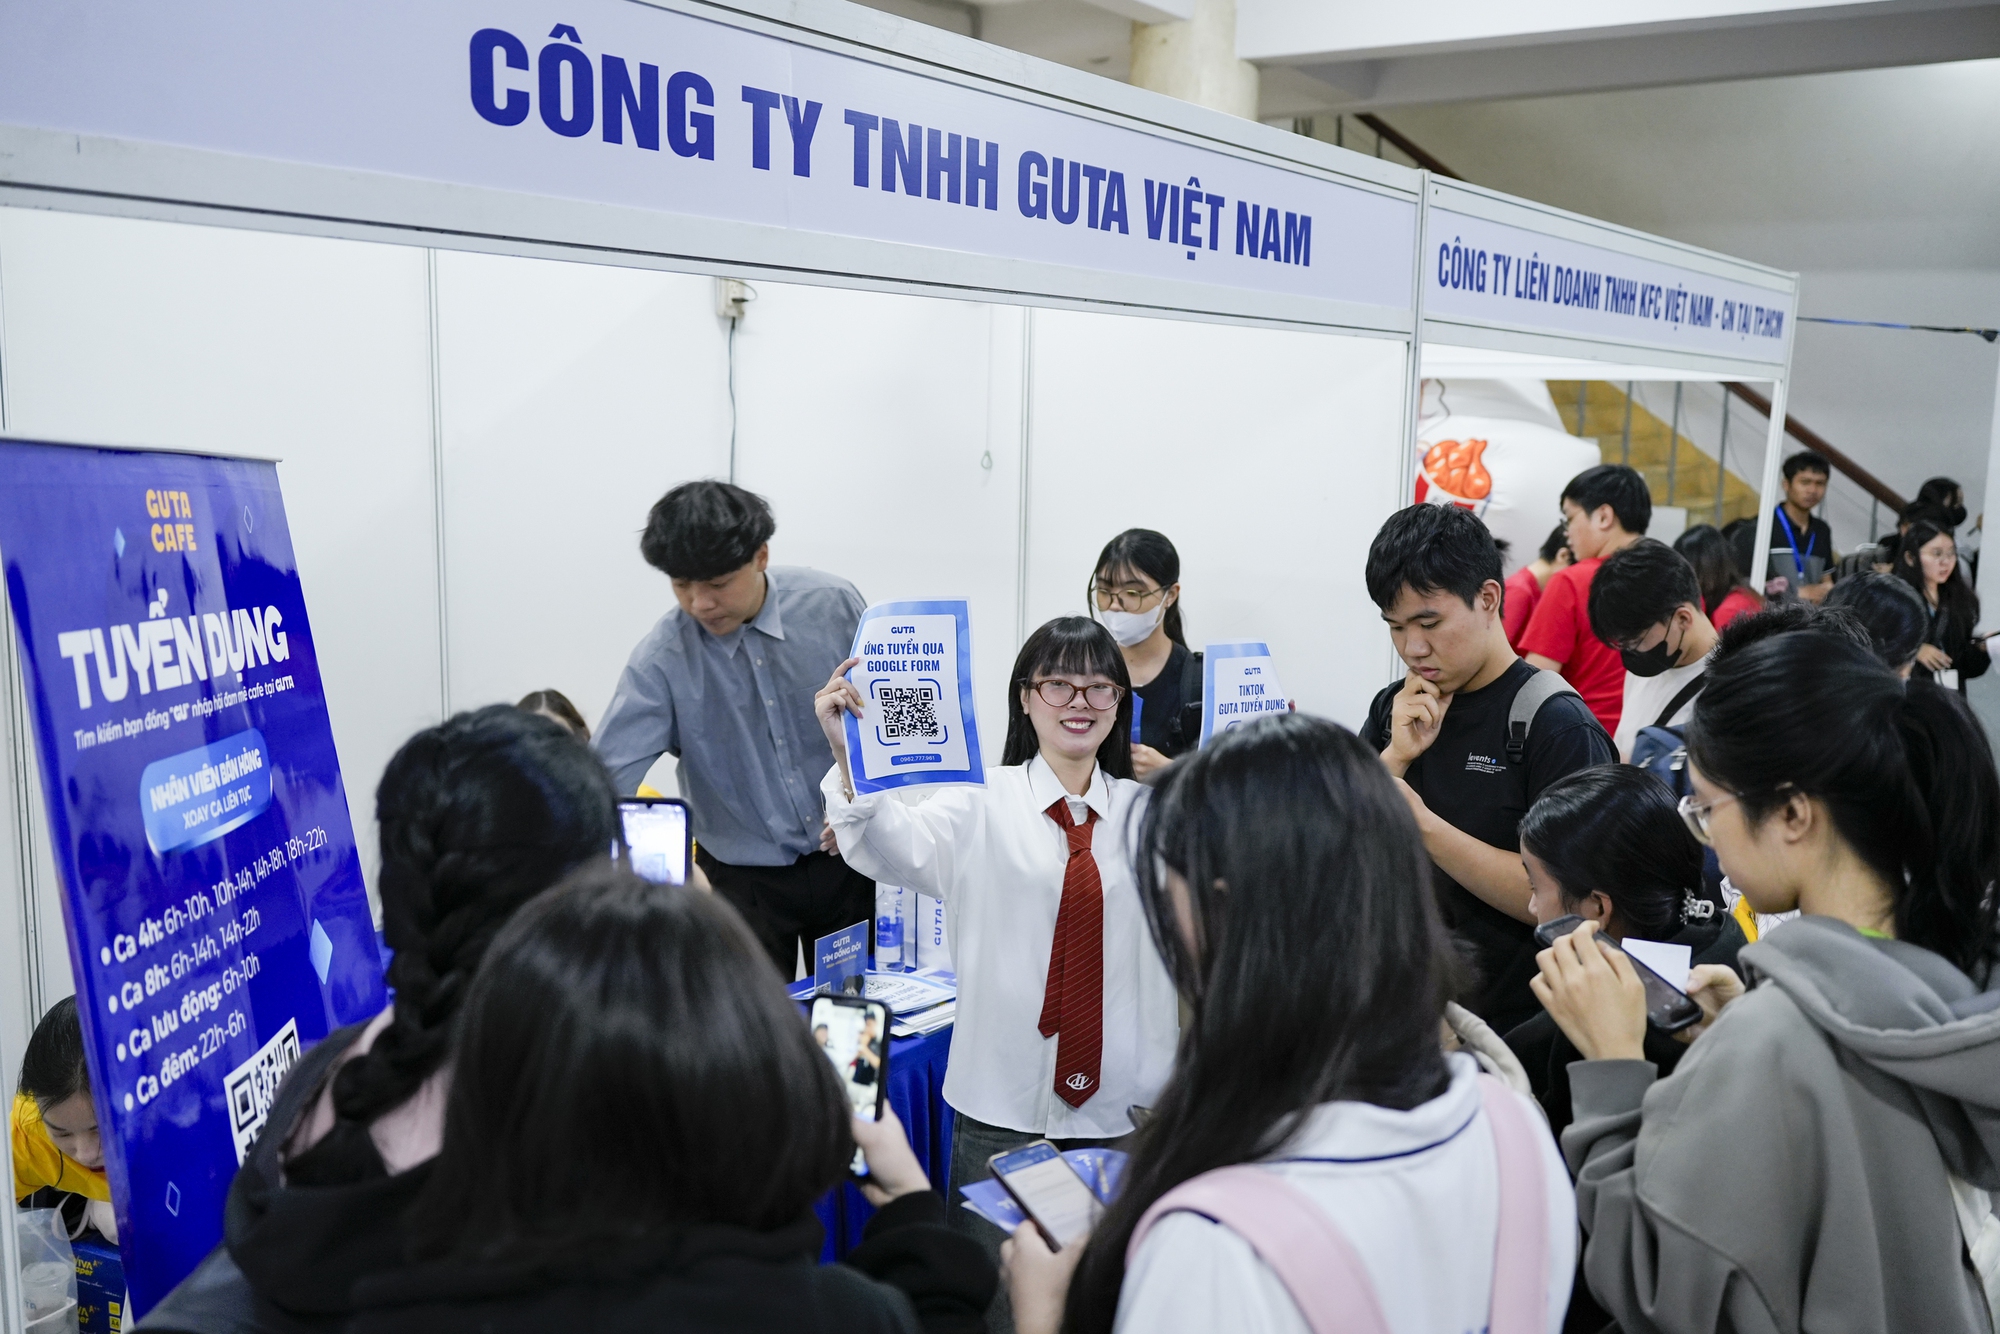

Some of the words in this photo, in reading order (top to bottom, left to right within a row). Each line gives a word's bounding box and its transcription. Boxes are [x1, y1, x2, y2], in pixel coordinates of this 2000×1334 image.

[469, 23, 715, 161] CÔNG
[741, 85, 823, 178] TY
[844, 108, 999, 211] TNHH
[1017, 150, 1129, 235] GUTA
[1144, 176, 1225, 261] VIỆT
[1235, 200, 1312, 267] NAM
[1438, 236, 1487, 293] CÔNG
[1493, 254, 1512, 297] TY
[1515, 252, 1550, 302] LIÊN
[1553, 265, 1601, 311] DOANH
[1604, 276, 1637, 316] TNHH
[1639, 283, 1662, 320] KFC
[1665, 282, 1688, 331] VIỆT
[1688, 293, 1714, 327] NAM
[1721, 299, 1737, 331] CN
[1737, 302, 1753, 341] TẠI
[1753, 306, 1784, 339] TP.HCM
[146, 489, 192, 518] GUTA
[151, 523, 197, 552] CAFE
[58, 588, 208, 710] TUYỂN
[203, 605, 290, 683] DỤNG
[864, 641, 884, 655] ỨNG
[887, 638, 919, 655] TUYỂN
[922, 642, 944, 656] QUA
[890, 626, 915, 634] GUTA
[867, 660, 907, 672] GOOGLE
[910, 660, 940, 672] FORM
[1244, 667, 1261, 675] GUTA
[96, 718, 123, 745] kiếm
[123, 717, 144, 739] bạn
[191, 697, 213, 718] nhập
[213, 692, 224, 713] hội
[224, 691, 238, 708] đam
[237, 686, 248, 703] mê
[248, 682, 264, 700] cafe
[264, 678, 275, 698] tại
[275, 675, 295, 692] GUTA
[1218, 702, 1238, 715] GUTA
[1240, 696, 1263, 713] TUYỂN
[1265, 698, 1285, 713] DỤNG
[1239, 684, 1264, 696] TIKTOK
[149, 774, 190, 813] NHÂN
[188, 763, 221, 797] VIÊN
[219, 753, 240, 786] BÁN
[237, 746, 263, 777] HÀNG
[182, 804, 209, 830] XOAY
[210, 799, 224, 818] CA
[222, 789, 240, 813] LIÊN
[238, 785, 253, 806] TỤC
[113, 934, 137, 963] Ca
[138, 914, 164, 948] 4h:
[163, 894, 214, 935] 6h-10h,
[212, 867, 256, 910] 10h-14h,
[253, 848, 288, 887] 14h-18h,
[285, 825, 328, 860] 18h-22h
[833, 936, 850, 948] GUTA
[934, 908, 943, 946] GUTA
[121, 982, 144, 1011] Ca
[145, 963, 170, 995] 8h:
[171, 935, 221, 979] 6h-14h,
[219, 906, 261, 947] 14h-22h
[128, 1029, 151, 1057] Ca
[151, 1010, 179, 1043] lưu
[180, 982, 222, 1024] động:
[222, 952, 261, 995] 6h-10h
[136, 1076, 159, 1104] Ca
[160, 1044, 199, 1088] đêm:
[198, 1010, 247, 1060] 22h-6h
